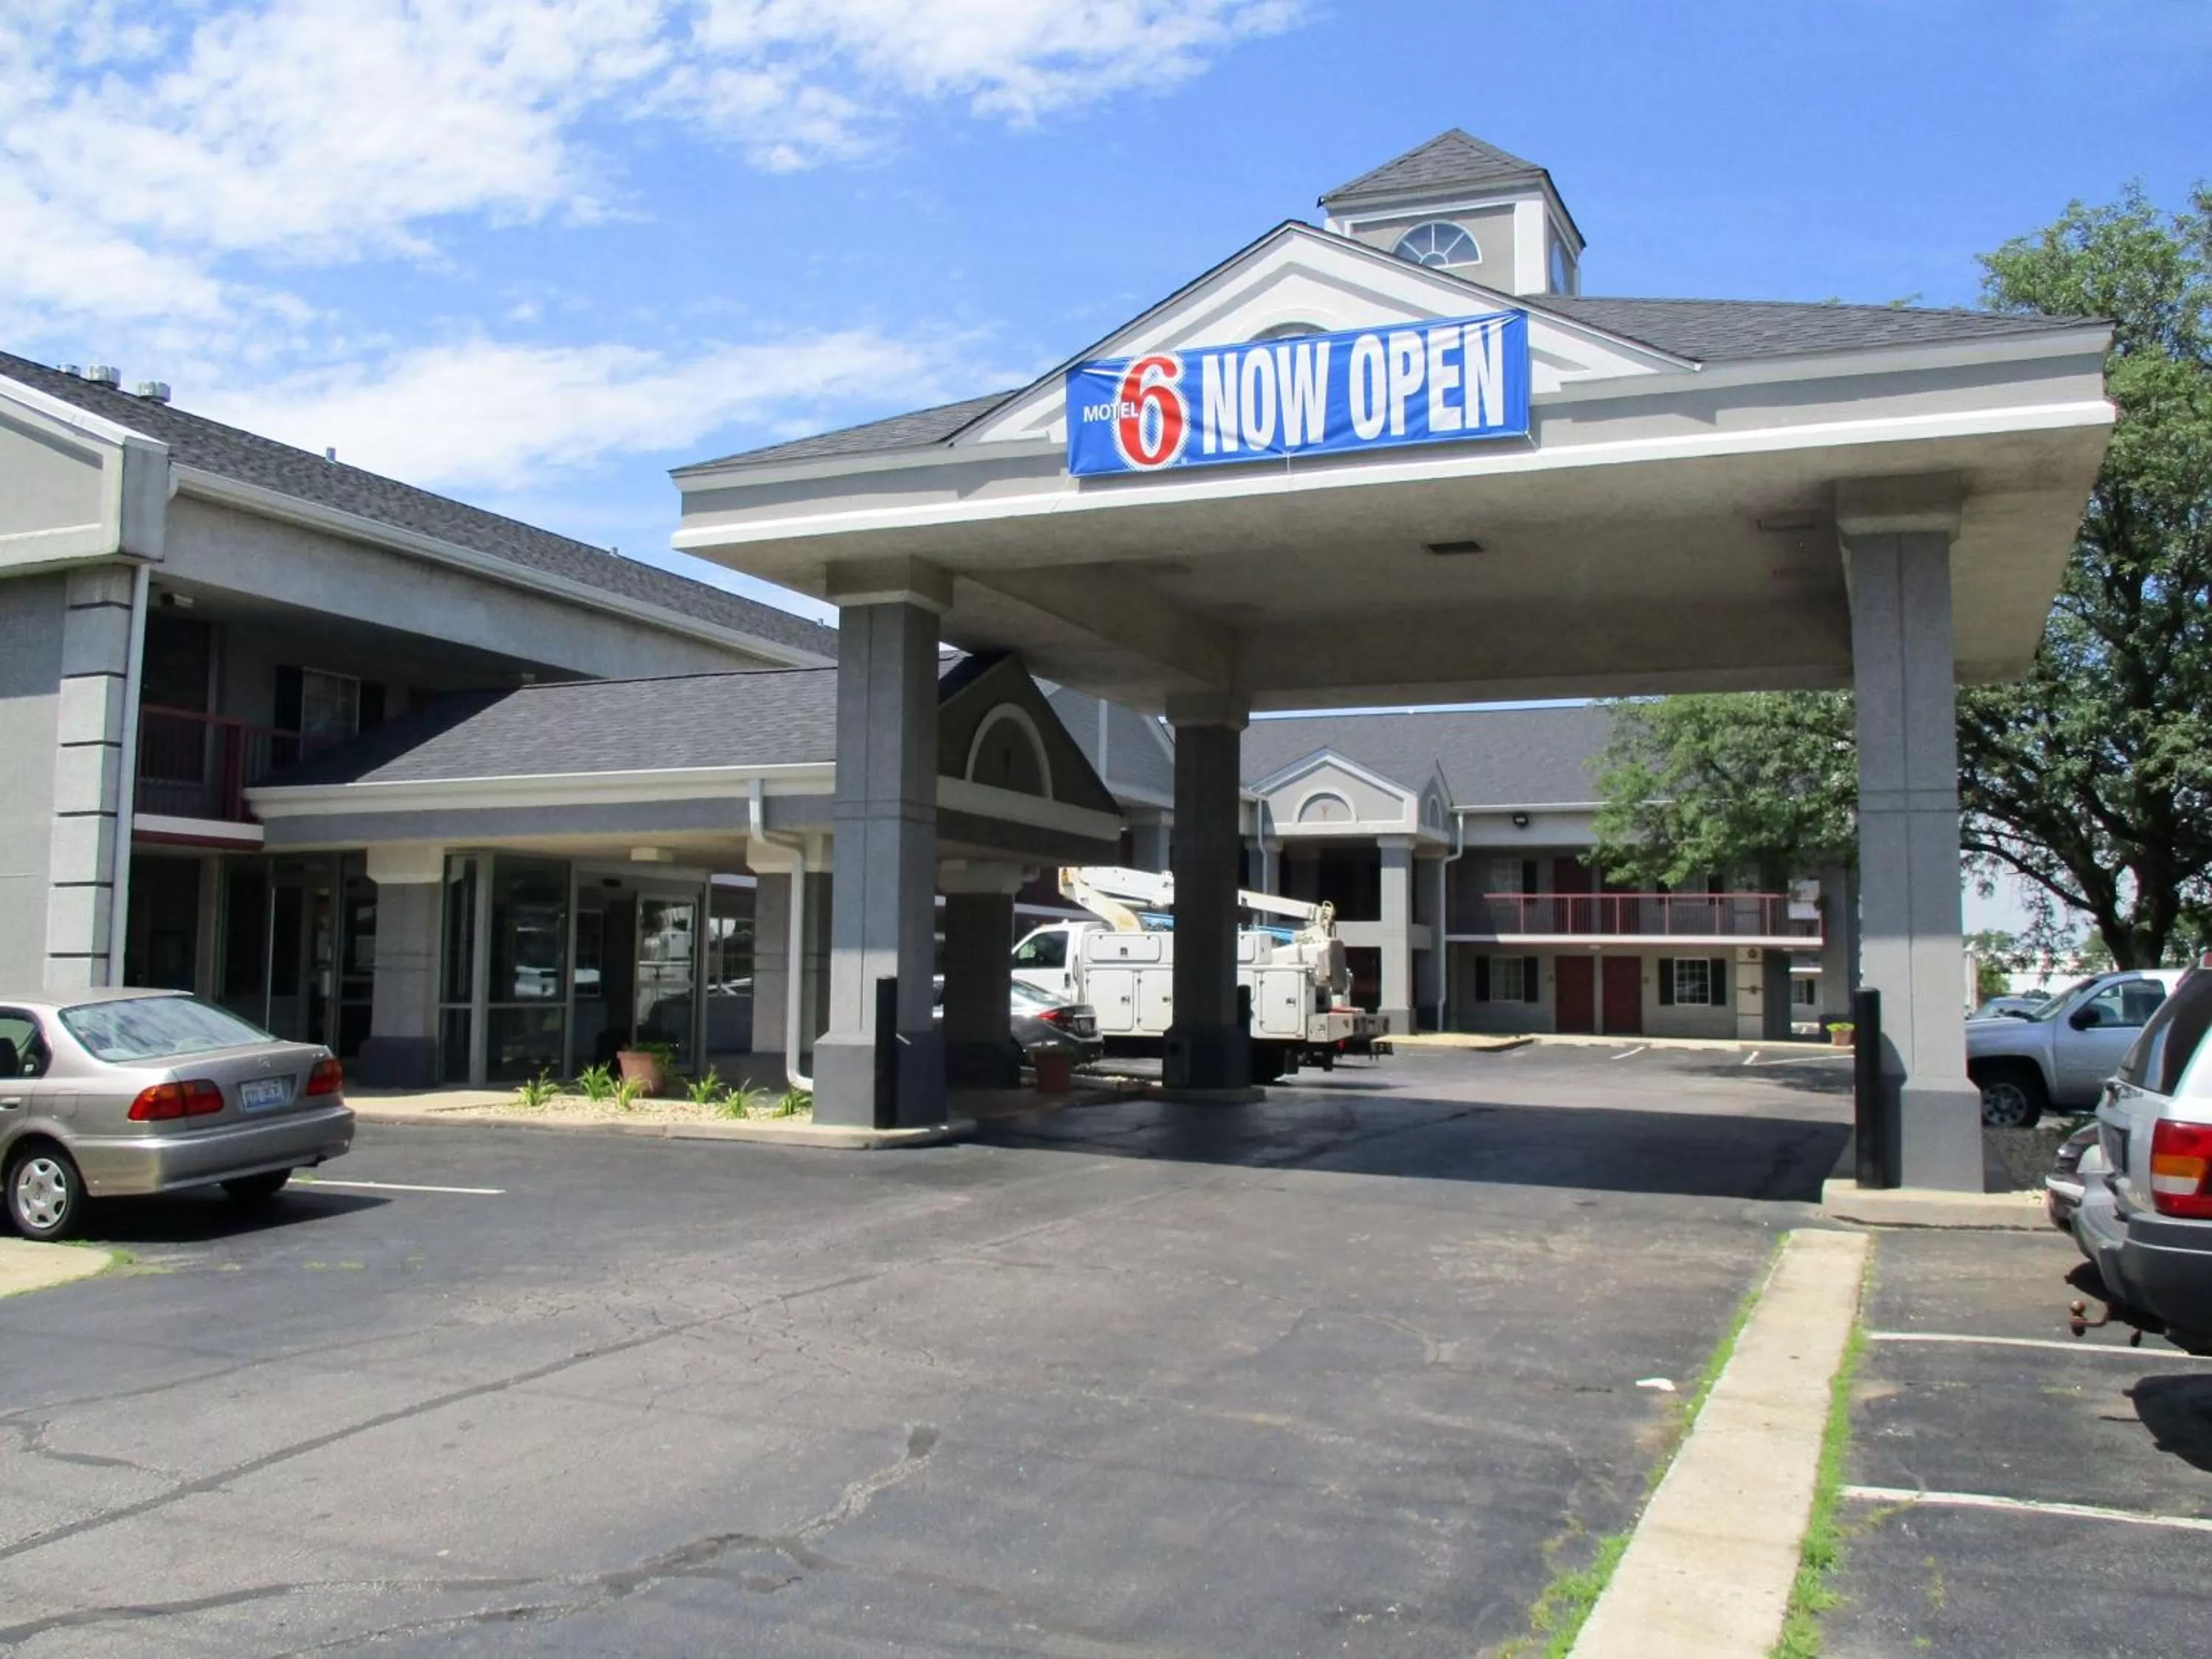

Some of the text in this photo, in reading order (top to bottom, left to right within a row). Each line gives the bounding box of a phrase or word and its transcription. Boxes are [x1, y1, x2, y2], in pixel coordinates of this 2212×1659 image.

[1083, 354, 1186, 467] MOTEL 6
[1202, 322, 1504, 455] NOW OPEN
